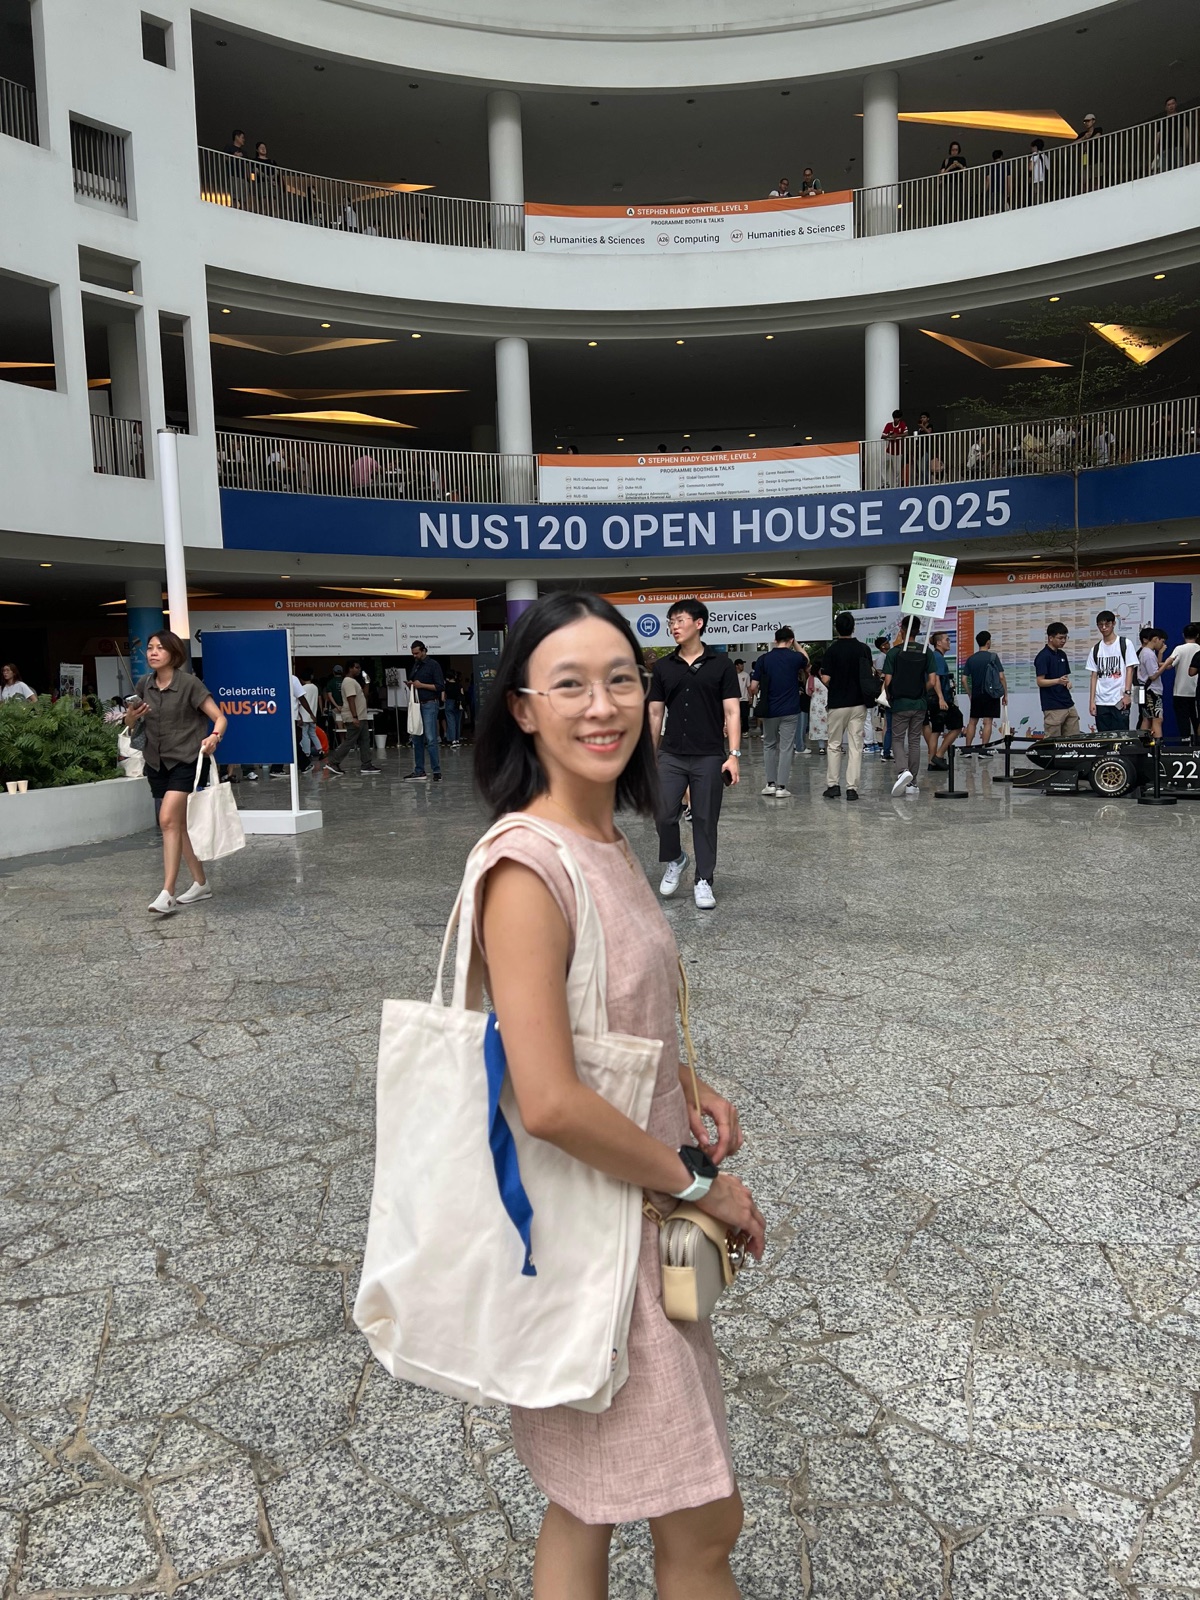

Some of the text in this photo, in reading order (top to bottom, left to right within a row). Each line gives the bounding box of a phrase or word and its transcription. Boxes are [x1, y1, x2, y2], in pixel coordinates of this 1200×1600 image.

[637, 208, 668, 216] STEPHEN
[692, 206, 720, 214] CENTRE,
[748, 224, 845, 239] Humanities & Sciences
[550, 236, 597, 244] Humanities
[608, 236, 645, 245] Sciences
[674, 233, 719, 245] Computing
[701, 454, 729, 462] CENTRE,
[419, 489, 1011, 550] NUS120 OPEN HOUSE 2025
[648, 593, 677, 602] STEPHEN
[700, 592, 726, 600] CENTRE,
[709, 611, 757, 623] Services
[752, 623, 782, 633] Parks)
[219, 687, 276, 697] Celebrating
[220, 700, 277, 715] NUS120
[1172, 761, 1199, 779] 22
